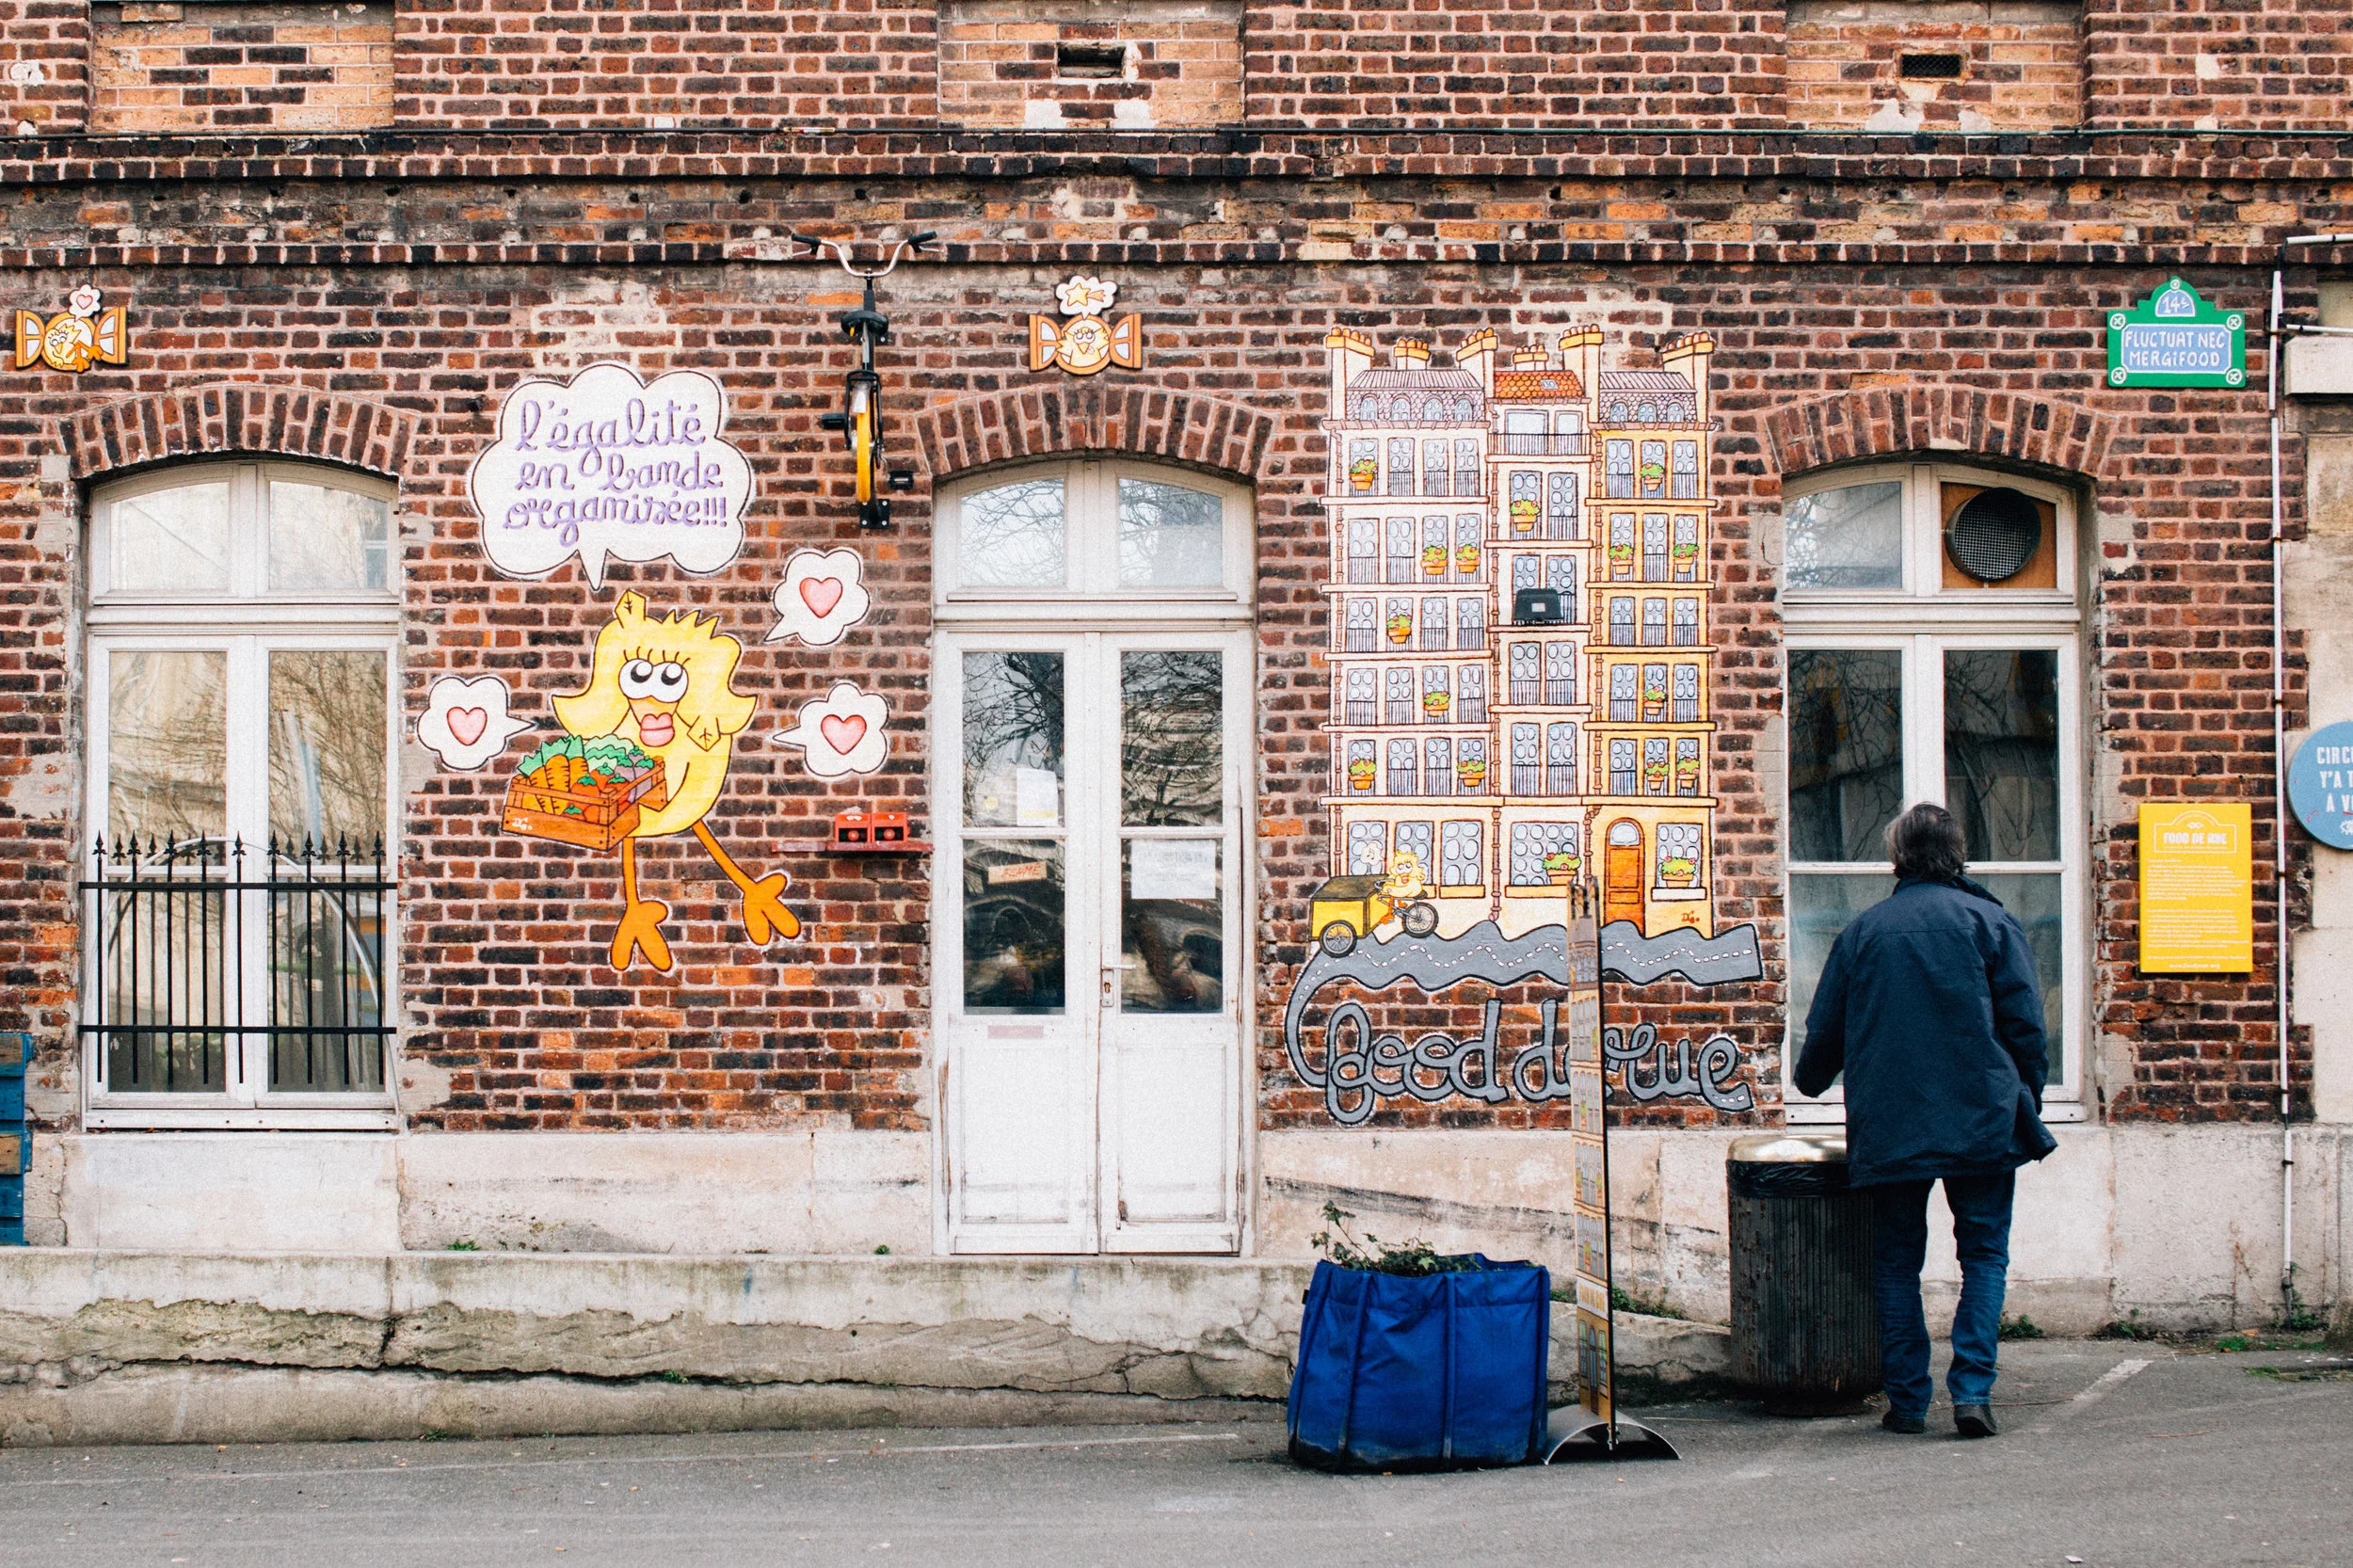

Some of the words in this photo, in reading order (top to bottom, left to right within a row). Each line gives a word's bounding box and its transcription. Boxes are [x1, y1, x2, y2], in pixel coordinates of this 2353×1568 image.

[2124, 330, 2193, 348] FLUCTUAT
[2198, 331, 2226, 349] NEC
[515, 397, 706, 477] l'égalité
[514, 461, 575, 491] en
[599, 451, 724, 493] bande
[2316, 746, 2353, 764] CIRC
[2319, 770, 2343, 789] Y'A
[2163, 832, 2190, 844] FOOD
[2191, 833, 2205, 844] DE
[2207, 833, 2228, 844] RUE
[1325, 998, 1511, 1127] food
[1603, 1022, 1754, 1114] rue
